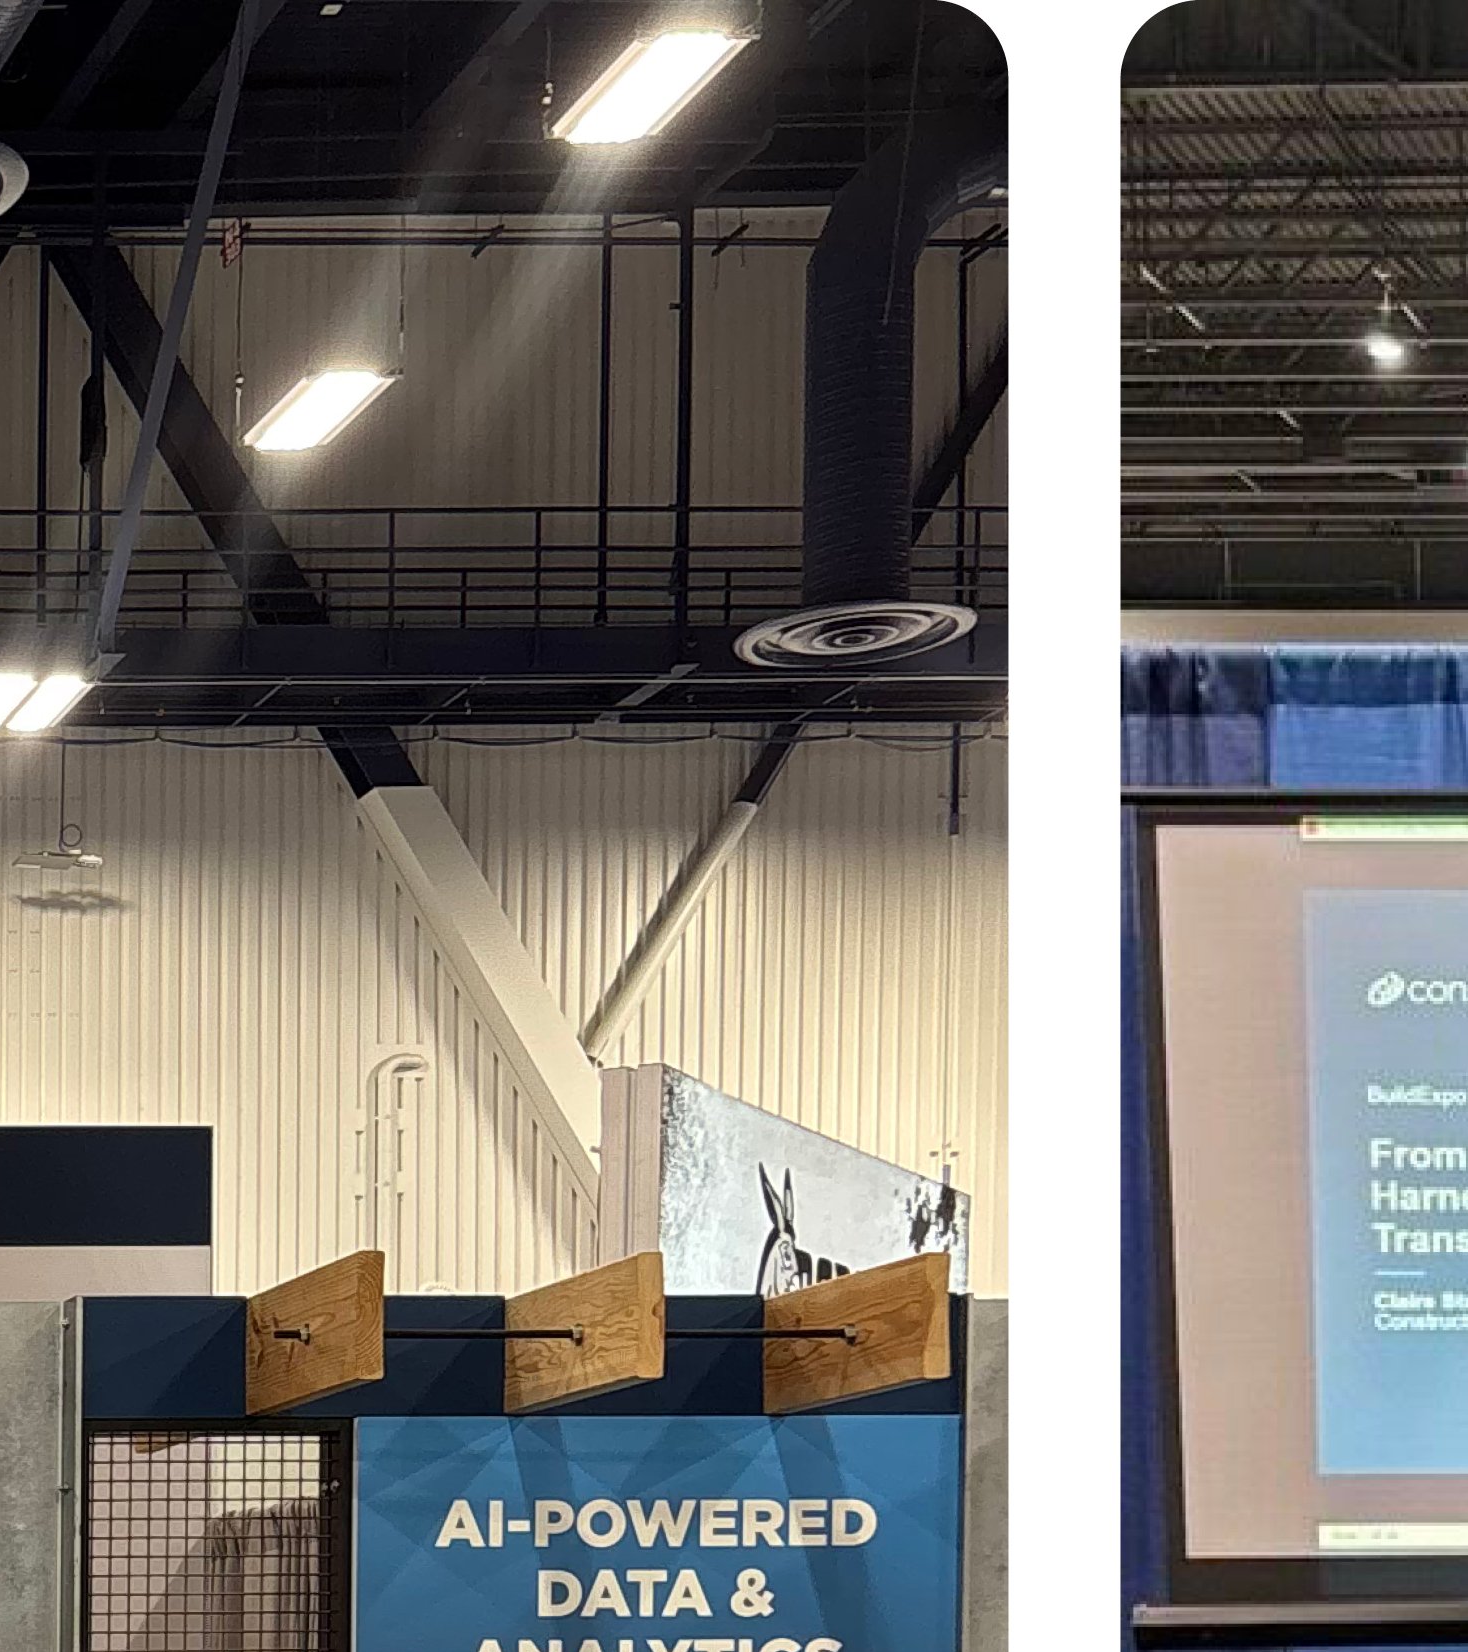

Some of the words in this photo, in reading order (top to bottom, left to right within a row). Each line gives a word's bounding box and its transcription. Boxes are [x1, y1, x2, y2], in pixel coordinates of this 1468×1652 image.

[1367, 1084, 1467, 1109] BuildExpo
[1370, 1137, 1466, 1171] From
[1373, 1291, 1435, 1311] Claire
[435, 1498, 878, 1548] AI-POWERED
[537, 1569, 699, 1618] DATA
[730, 1569, 775, 1618] &
